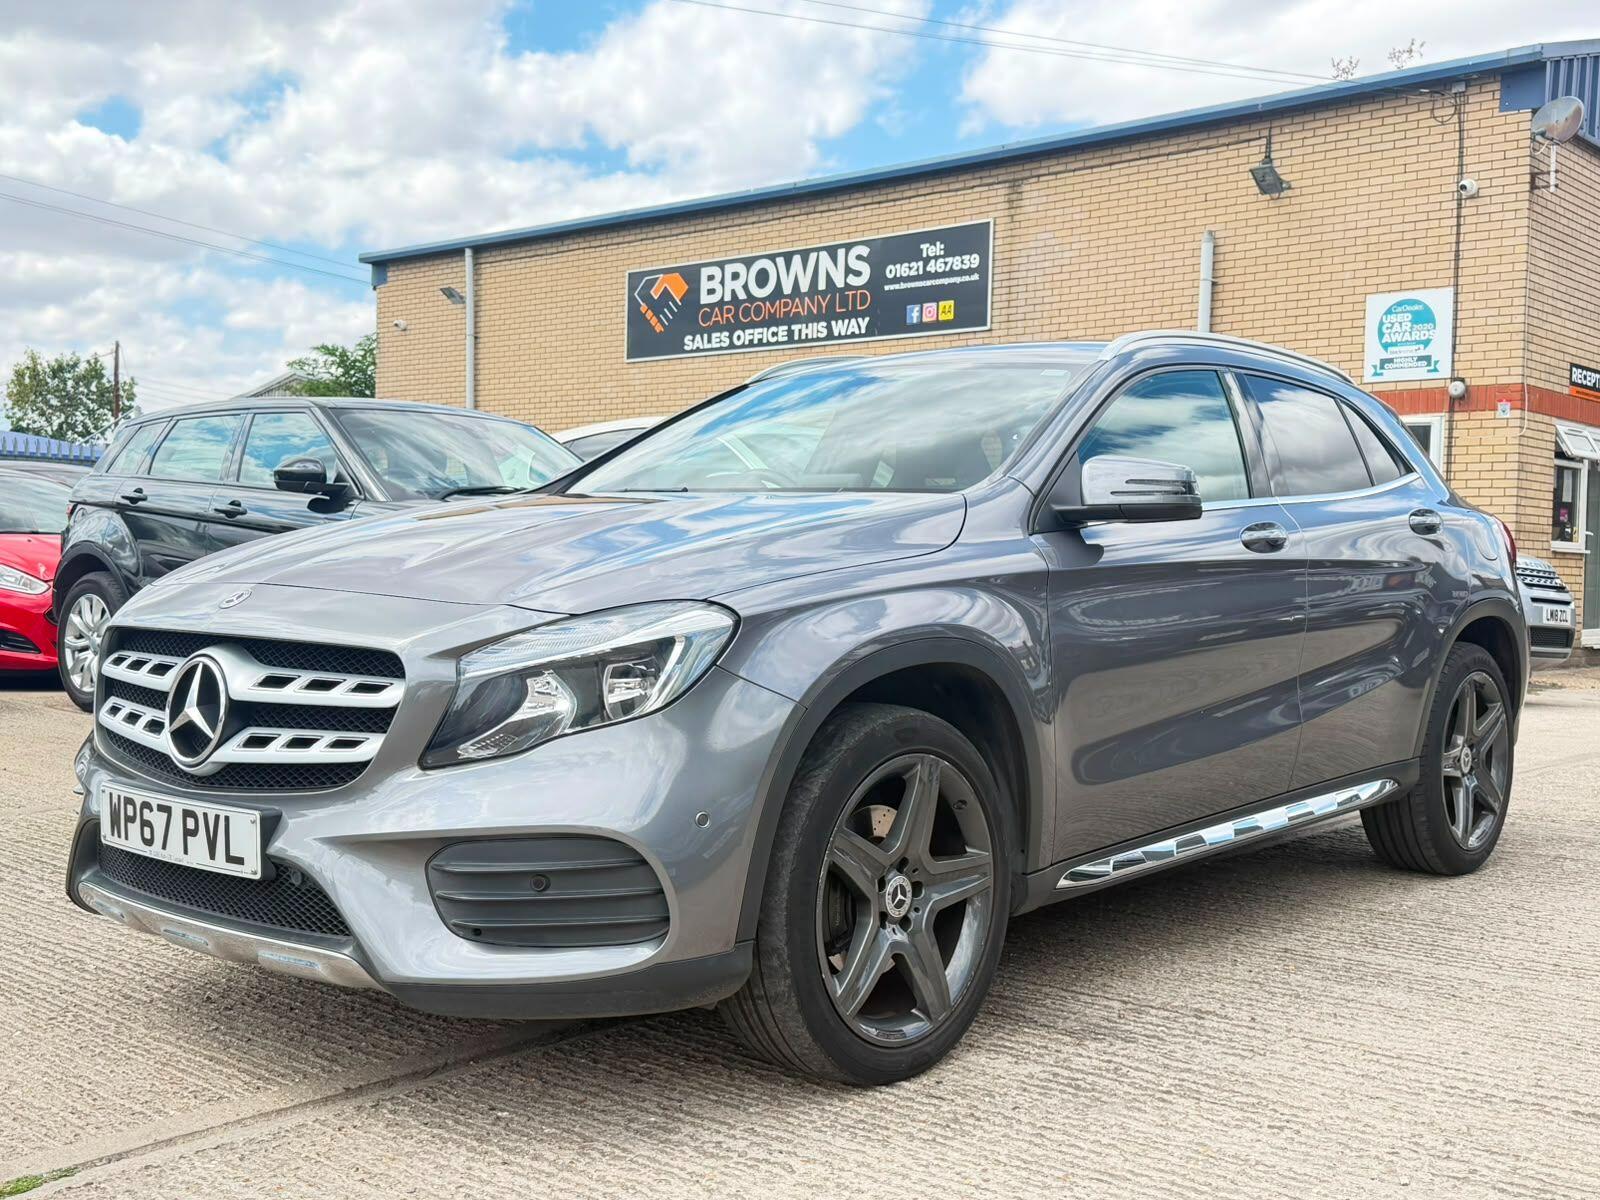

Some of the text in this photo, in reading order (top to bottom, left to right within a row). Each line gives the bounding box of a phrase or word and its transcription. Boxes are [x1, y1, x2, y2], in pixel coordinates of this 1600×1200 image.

[920, 241, 945, 258] Tel:
[700, 245, 871, 304] BROWNS
[885, 253, 980, 279] 01621 467839
[698, 290, 871, 328] CAR COMPANY LTD
[1382, 313, 1411, 322] USED
[683, 317, 870, 351] SALES OFFICE THIS WAY
[1381, 322, 1412, 333] CAR
[1381, 329, 1437, 343] AWARDS
[109, 791, 245, 866] WP67 PVL
